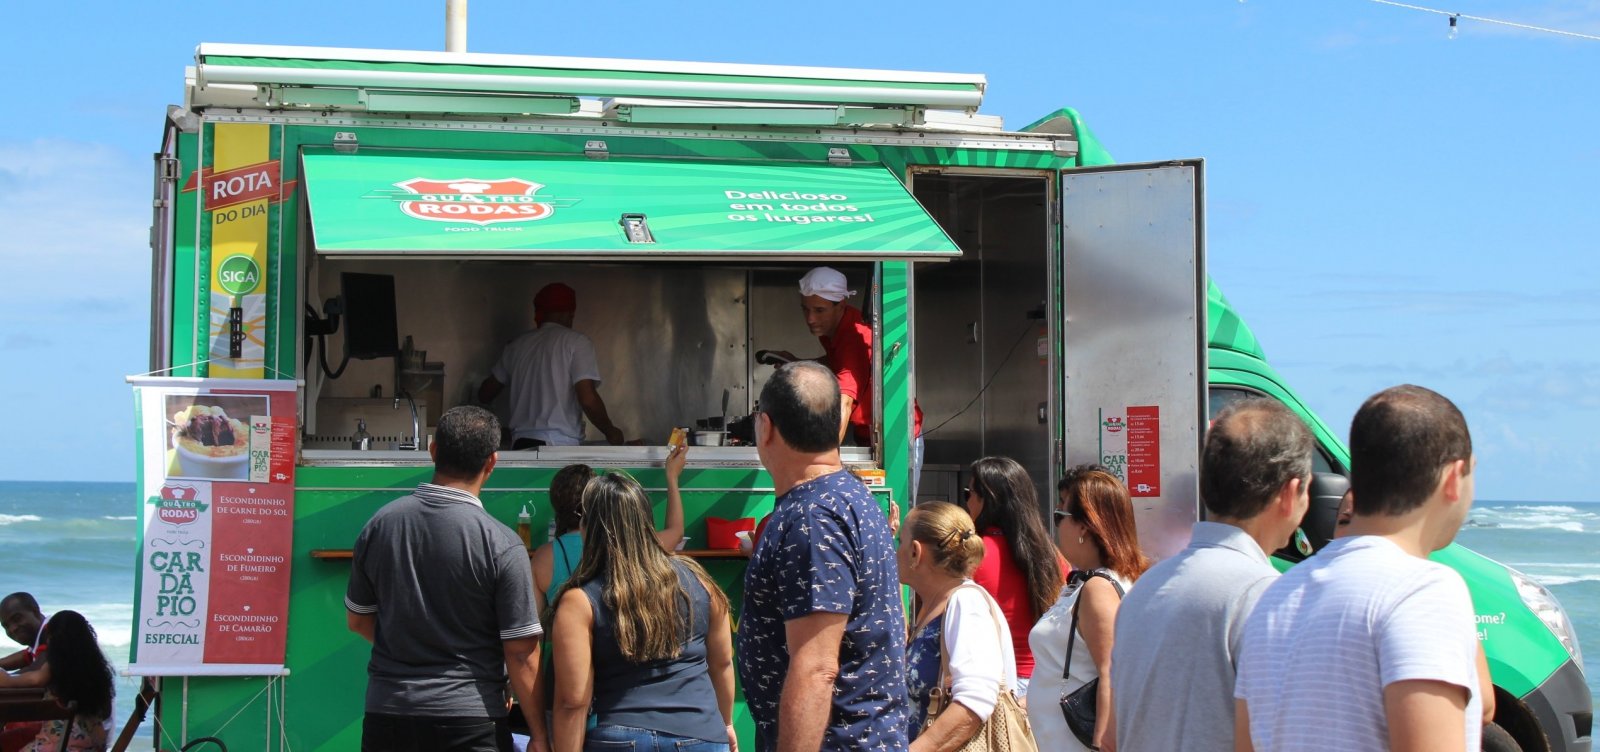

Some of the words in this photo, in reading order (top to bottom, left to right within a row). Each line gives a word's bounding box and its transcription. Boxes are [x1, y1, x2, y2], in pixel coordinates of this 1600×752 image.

[214, 171, 272, 200] ROTA
[724, 190, 848, 201] Delicioso
[419, 204, 538, 216] RODAS
[730, 203, 774, 211] em
[780, 202, 859, 212] todos
[216, 209, 237, 225] DO
[241, 203, 266, 218] DIA
[727, 213, 758, 222] os
[763, 212, 875, 225] lugares!
[222, 270, 256, 284] SIGA
[251, 450, 269, 458] CAR
[1103, 455, 1126, 465] CAR
[220, 496, 286, 506] ESCONDIDINHO
[161, 509, 196, 519] RODAS
[217, 506, 228, 514] DE
[230, 507, 257, 515] CARNE
[273, 508, 288, 516] SOL
[149, 551, 204, 573] CAR
[219, 553, 284, 563] ESCONDIDINHO
[227, 564, 238, 572] DE
[240, 564, 276, 573] FUMEIRO
[156, 595, 197, 617] PIO
[213, 614, 279, 624] ESCONDIDINHO
[1474, 612, 1506, 625] ome?
[219, 624, 231, 632] DE
[232, 623, 272, 633] CAMARÃO
[145, 634, 200, 645] ESPECIAL
